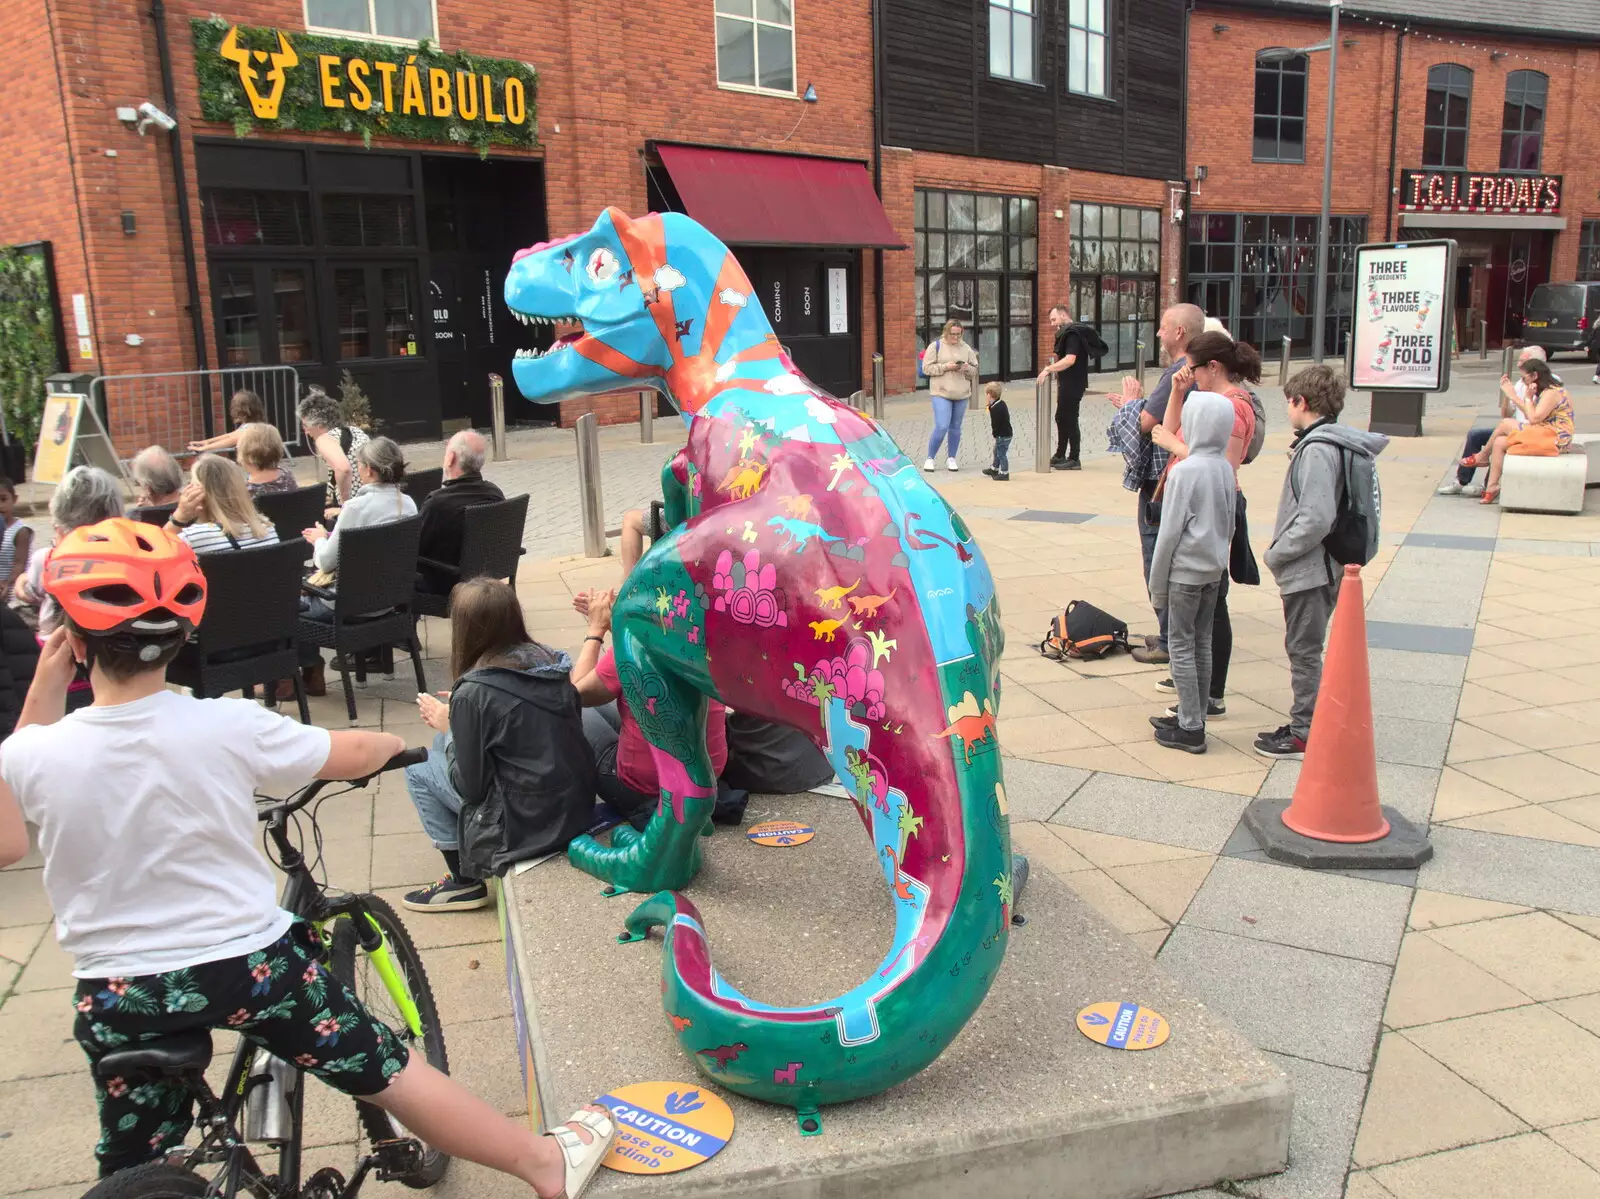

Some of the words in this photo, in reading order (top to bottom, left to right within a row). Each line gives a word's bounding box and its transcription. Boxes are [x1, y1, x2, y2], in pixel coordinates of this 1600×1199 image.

[316, 54, 526, 125] ESTÁBULO
[1410, 174, 1463, 204] T.G.I.
[1369, 261, 1407, 274] THREE
[1382, 291, 1420, 304] THREE
[433, 309, 449, 320] ULO
[1381, 304, 1420, 313] FLAVOURS
[1395, 335, 1433, 347] THREE
[1393, 348, 1432, 364] FOLD
[757, 829, 804, 838] CAUTION
[1113, 1009, 1134, 1041] CAUTION
[611, 1105, 702, 1147] CAUTION
[616, 1129, 652, 1149] ease
[651, 1144, 674, 1158] do
[615, 1146, 660, 1168] climb
